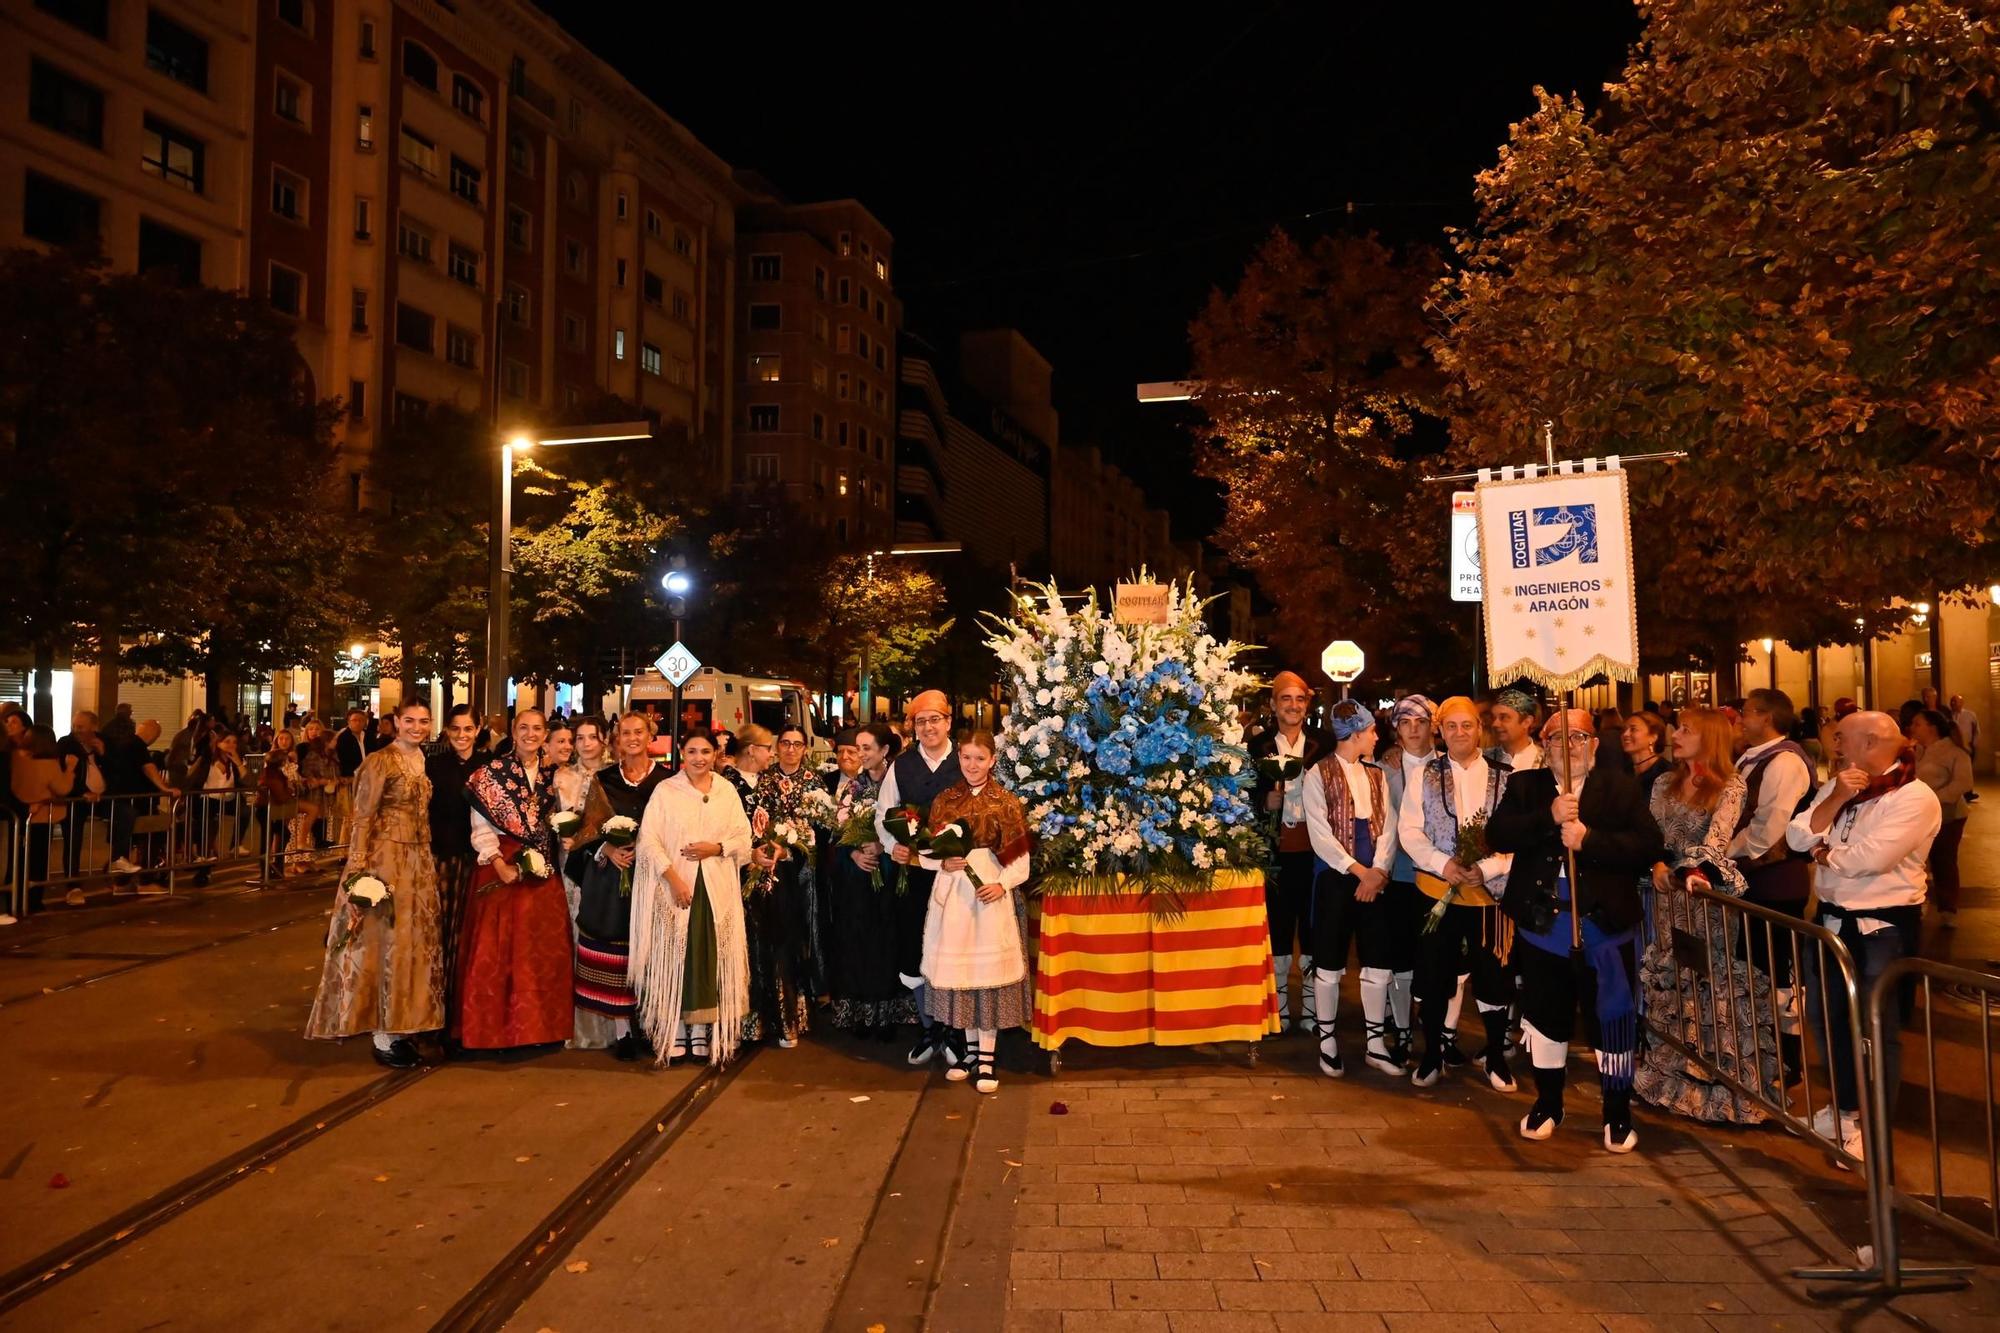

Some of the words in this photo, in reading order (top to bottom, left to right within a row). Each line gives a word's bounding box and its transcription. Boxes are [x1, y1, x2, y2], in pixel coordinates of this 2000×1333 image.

[1512, 511, 1526, 567] COGITIAR
[1461, 586, 1483, 594] PEA
[1515, 580, 1600, 596] INGENIEROS
[1529, 596, 1589, 612] ARAGÓN
[668, 656, 687, 671] 30
